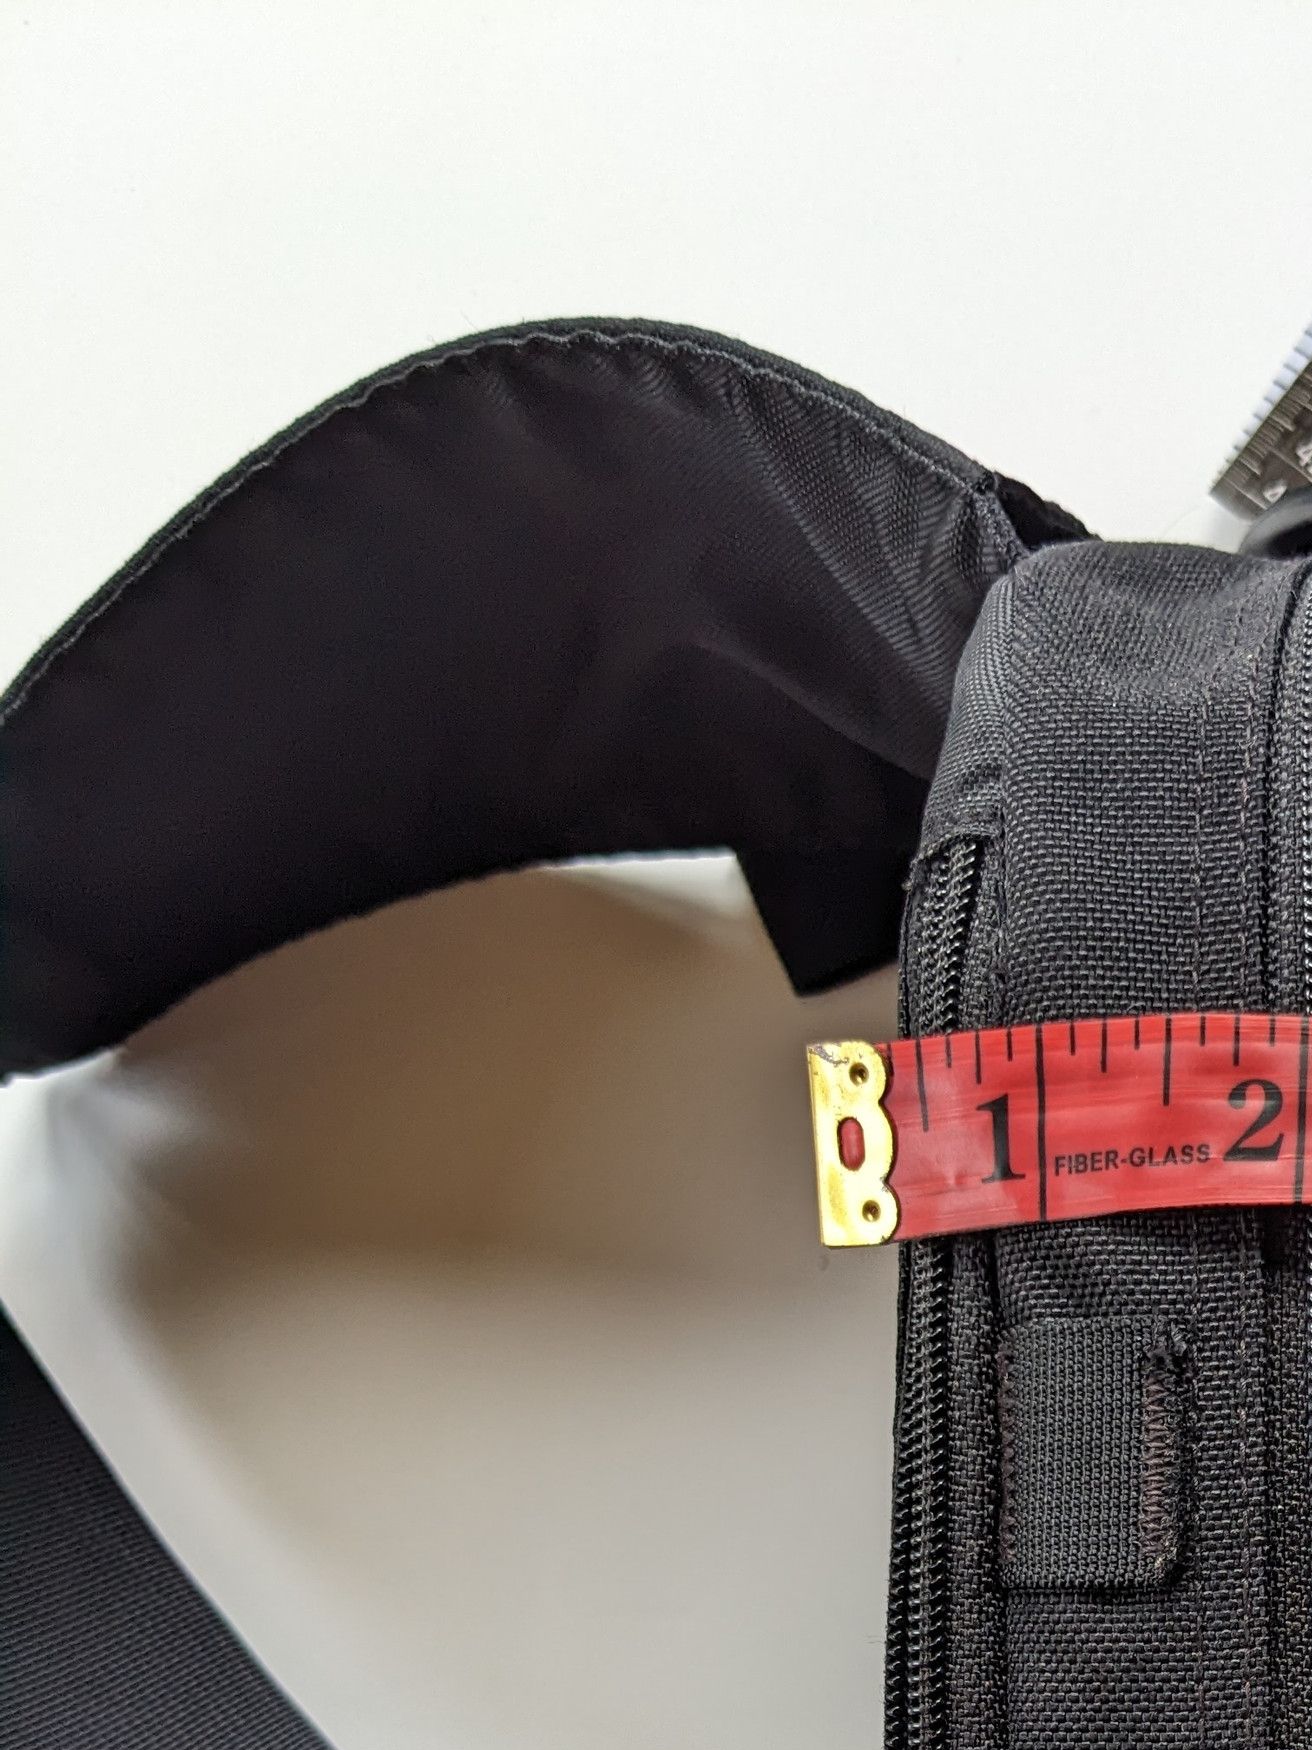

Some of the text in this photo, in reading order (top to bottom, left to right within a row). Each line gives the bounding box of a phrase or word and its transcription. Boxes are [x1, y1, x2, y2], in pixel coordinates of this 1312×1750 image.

[1263, 480, 1288, 503] 4
[977, 1094, 1026, 1183] 1
[1223, 1078, 1285, 1163] 2
[1053, 1143, 1211, 1178] FIBER-GLASS
